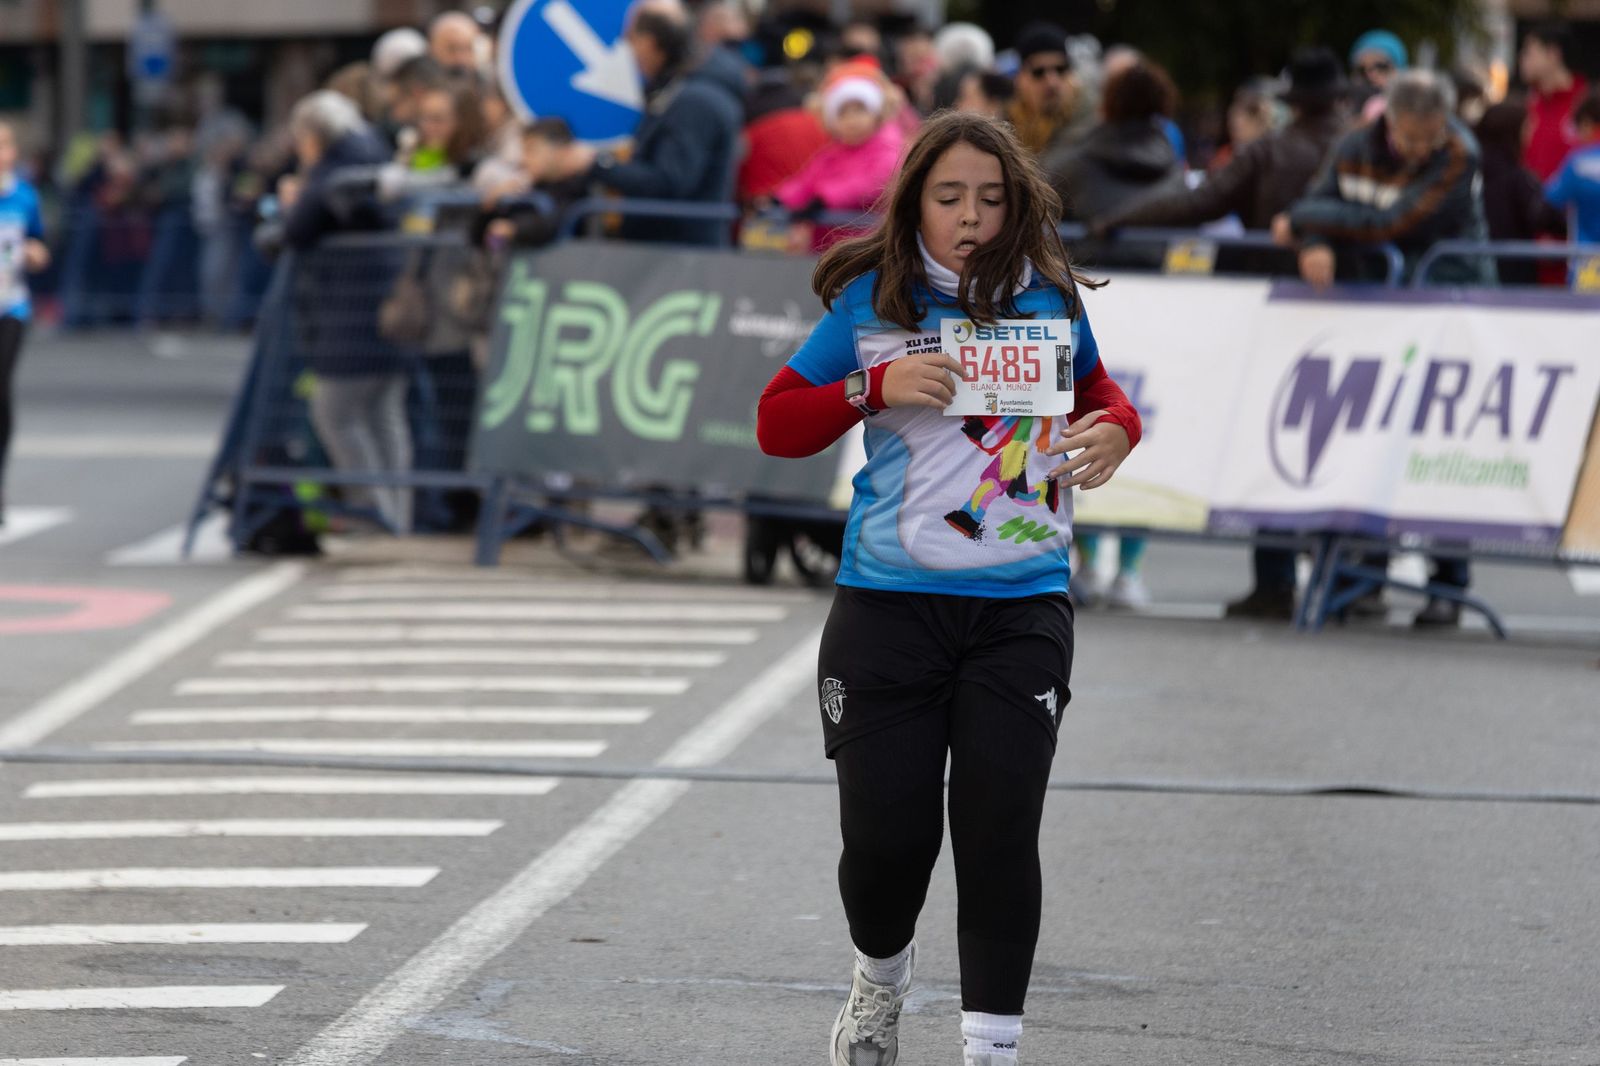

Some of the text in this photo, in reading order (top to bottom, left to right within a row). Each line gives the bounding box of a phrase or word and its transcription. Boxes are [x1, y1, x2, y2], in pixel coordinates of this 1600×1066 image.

[975, 325, 1058, 341] SETEL
[905, 339, 921, 348] XLI
[959, 345, 1041, 383] 6485
[970, 382, 1032, 391] BLANCA MUÑOZ
[999, 399, 1033, 407] Ayuntamiento
